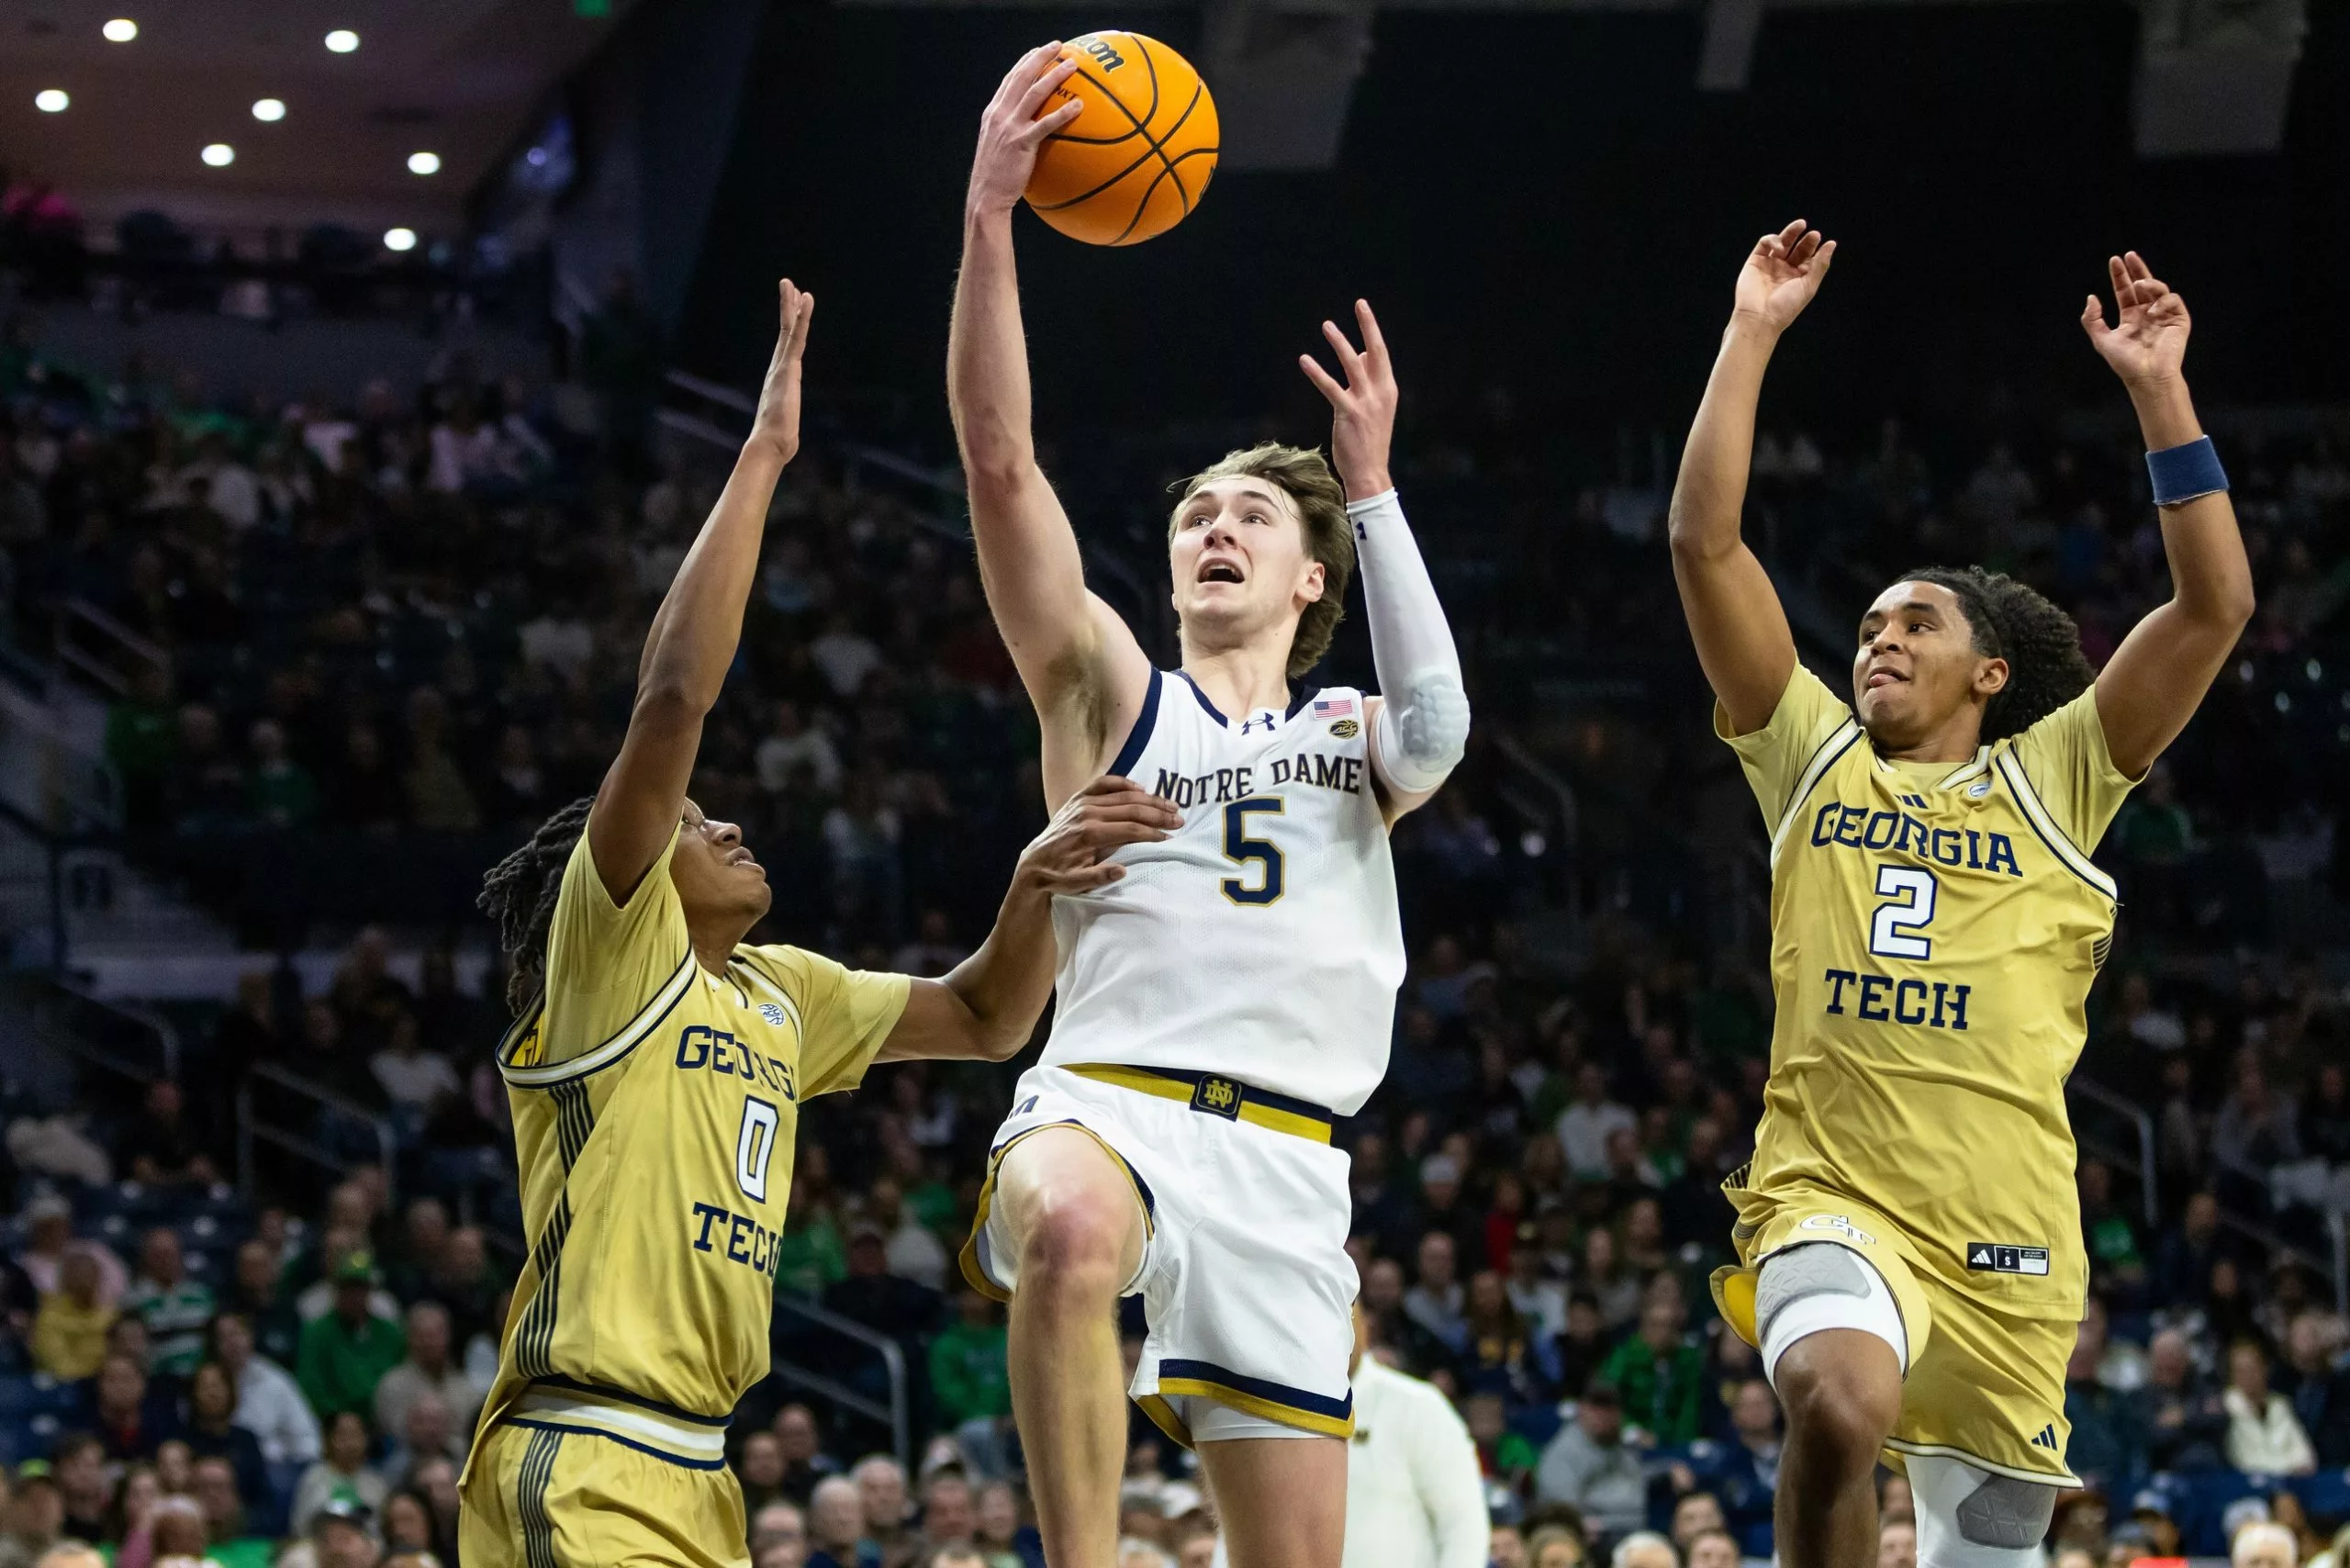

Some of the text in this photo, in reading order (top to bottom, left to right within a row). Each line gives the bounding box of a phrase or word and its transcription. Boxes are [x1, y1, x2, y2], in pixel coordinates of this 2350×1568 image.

[1154, 753, 1363, 809] NOTRE DAME
[1219, 796, 1286, 907] 5
[1809, 801, 2024, 879] GEORGIA
[1869, 863, 1939, 961] 2
[1824, 968, 1972, 1031] TECH
[736, 1093, 780, 1205] 0
[2004, 1255, 2011, 1267] S
